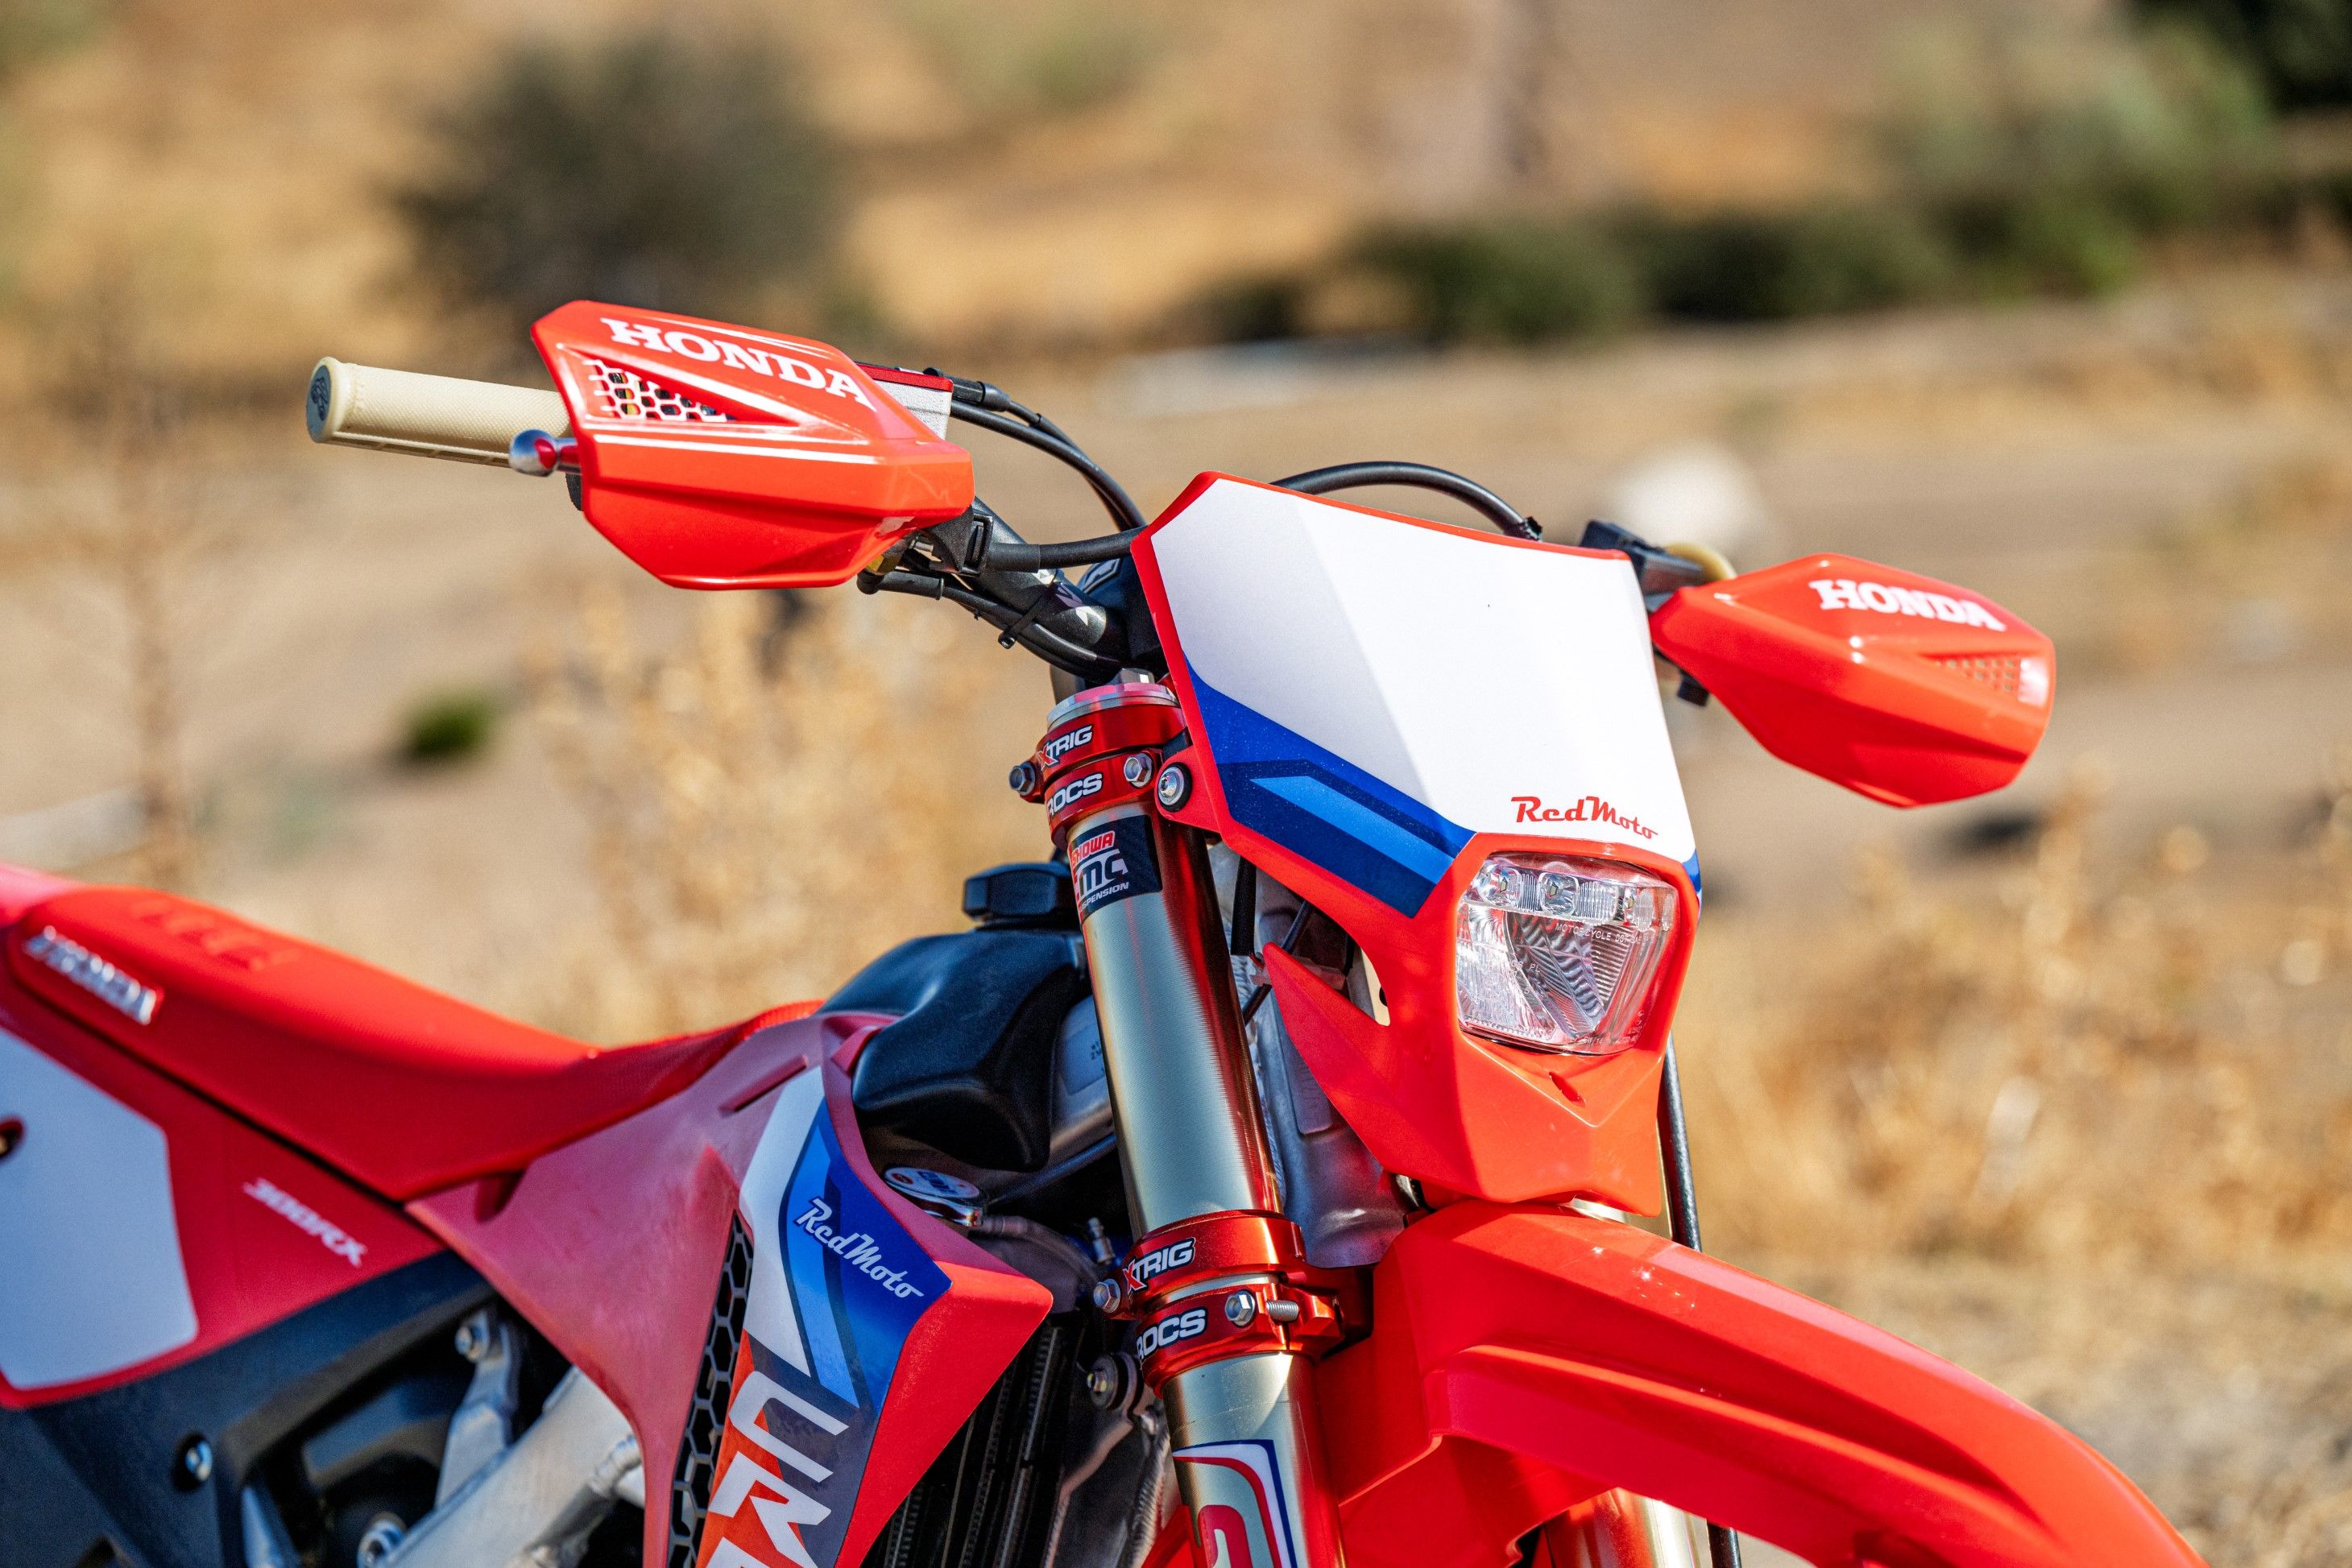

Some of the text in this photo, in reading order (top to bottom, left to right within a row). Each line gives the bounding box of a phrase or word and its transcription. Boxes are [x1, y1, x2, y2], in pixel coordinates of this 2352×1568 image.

[600, 316, 877, 412] HONDA
[1808, 579, 2006, 632] HONDA
[1037, 725, 1093, 772] XTRIG
[1510, 796, 1658, 839] RedMoto
[1080, 882, 1129, 912] SPENSION
[796, 1198, 925, 1298] RedMoto
[1122, 1240, 1193, 1295] XTRIG
